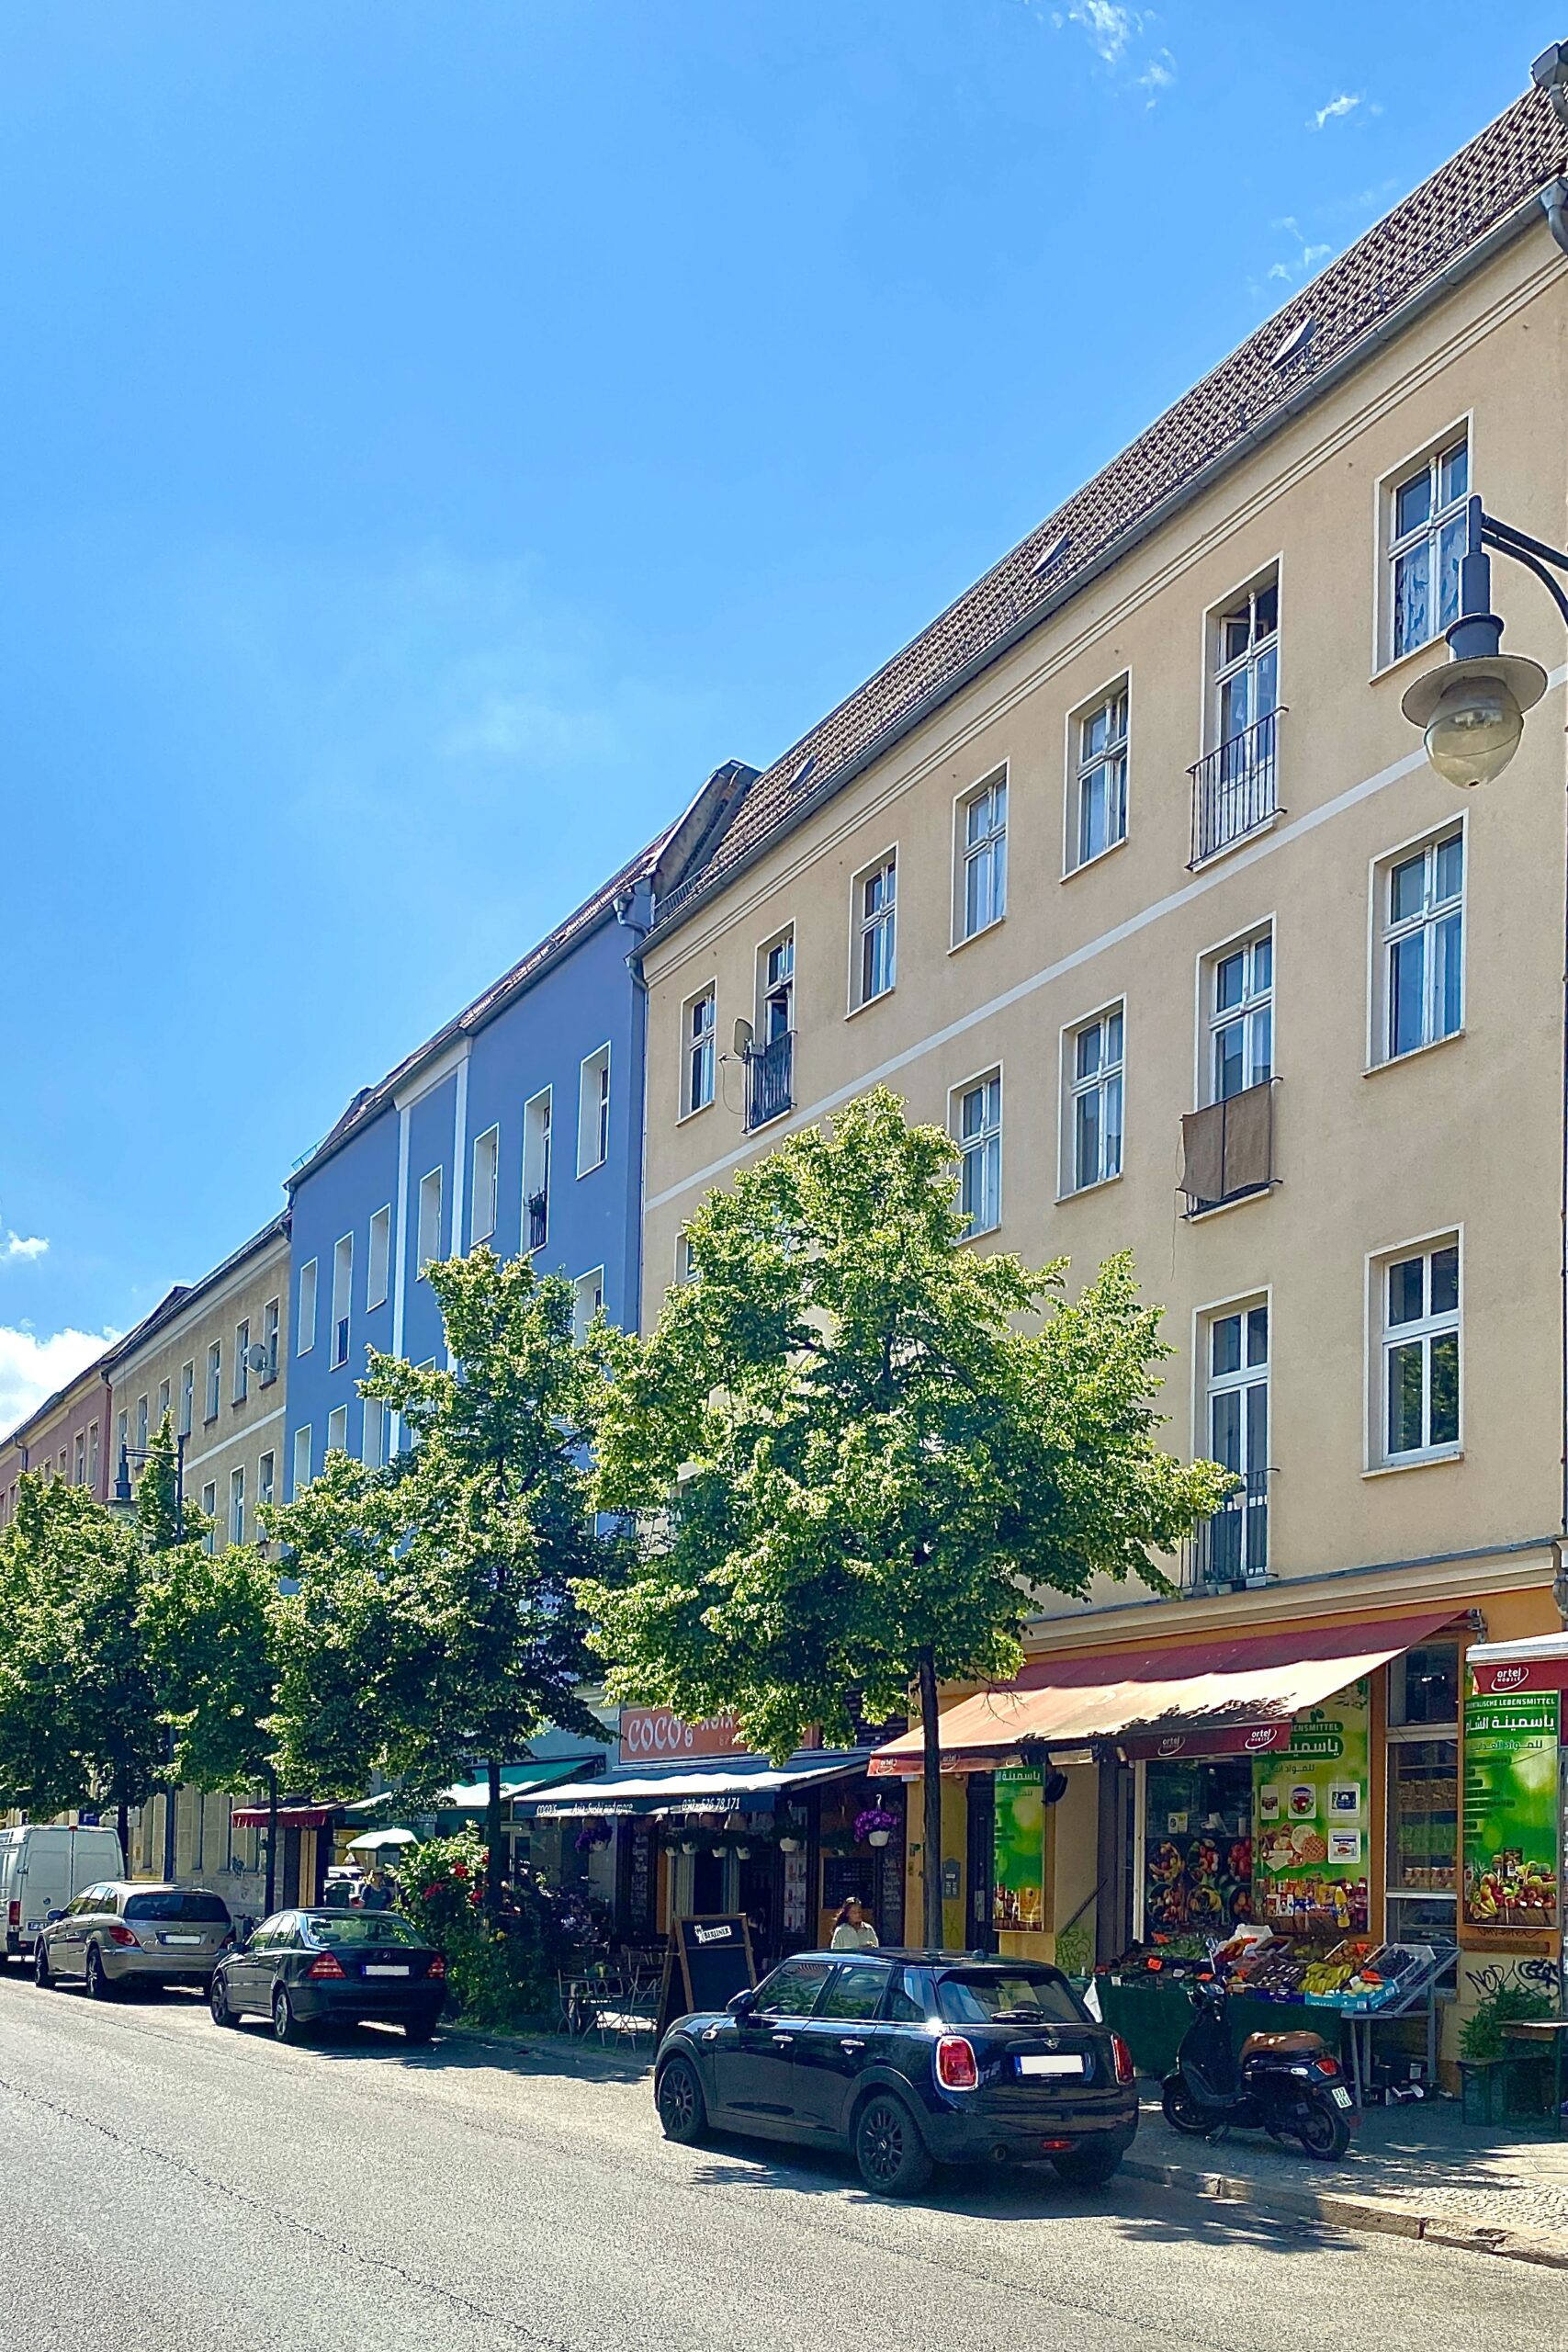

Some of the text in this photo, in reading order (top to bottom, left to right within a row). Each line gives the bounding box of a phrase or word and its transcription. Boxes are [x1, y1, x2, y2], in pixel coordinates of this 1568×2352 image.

[1497, 1668, 1521, 1678] ortel
[1499, 1697, 1555, 1706] LEBENSMITTEL
[1491, 1714, 1555, 1731] ياسمينة
[1252, 1729, 1271, 1738] ortel
